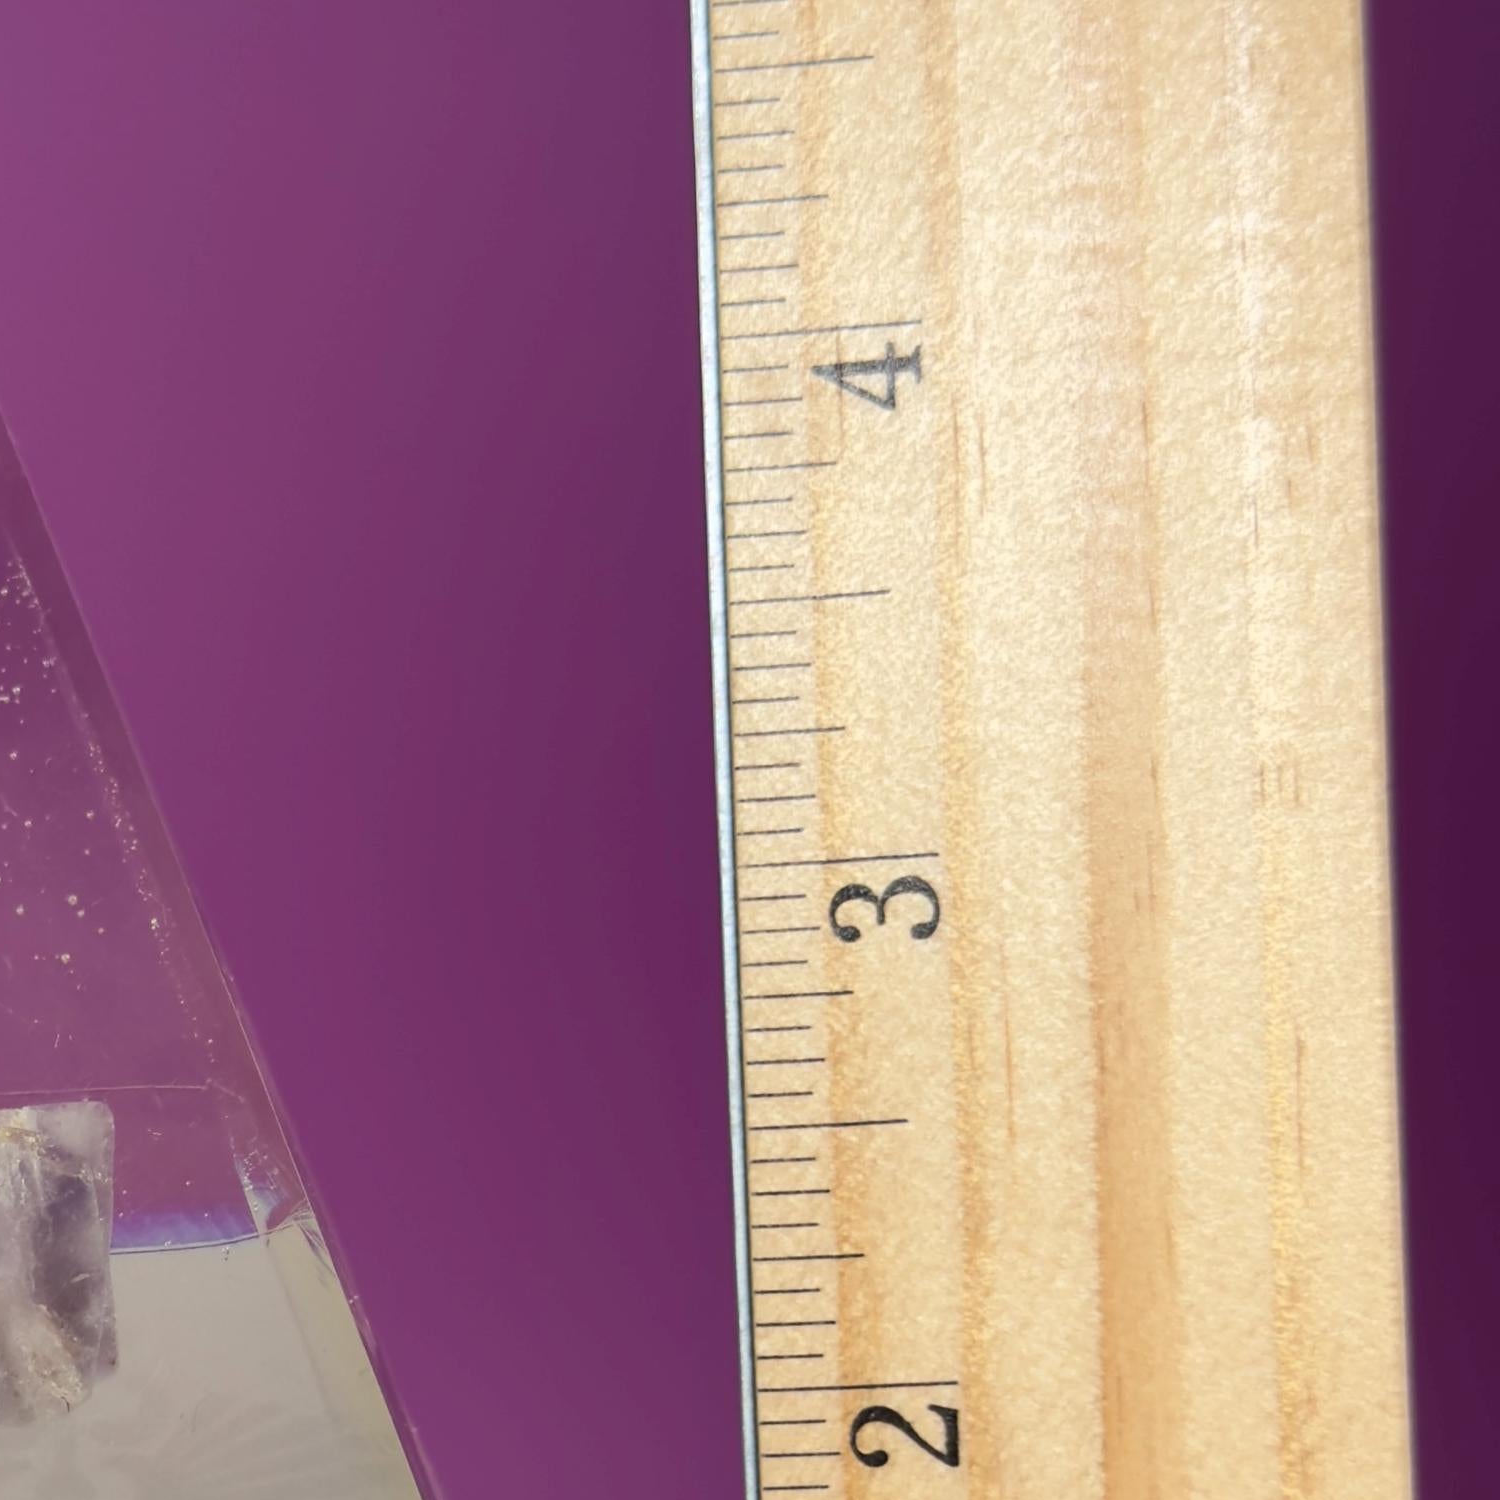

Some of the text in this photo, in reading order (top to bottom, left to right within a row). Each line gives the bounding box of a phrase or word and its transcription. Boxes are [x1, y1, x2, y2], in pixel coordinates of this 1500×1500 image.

[811, 341, 922, 411] 4
[829, 875, 941, 943] 3
[849, 1404, 961, 1469] 2
